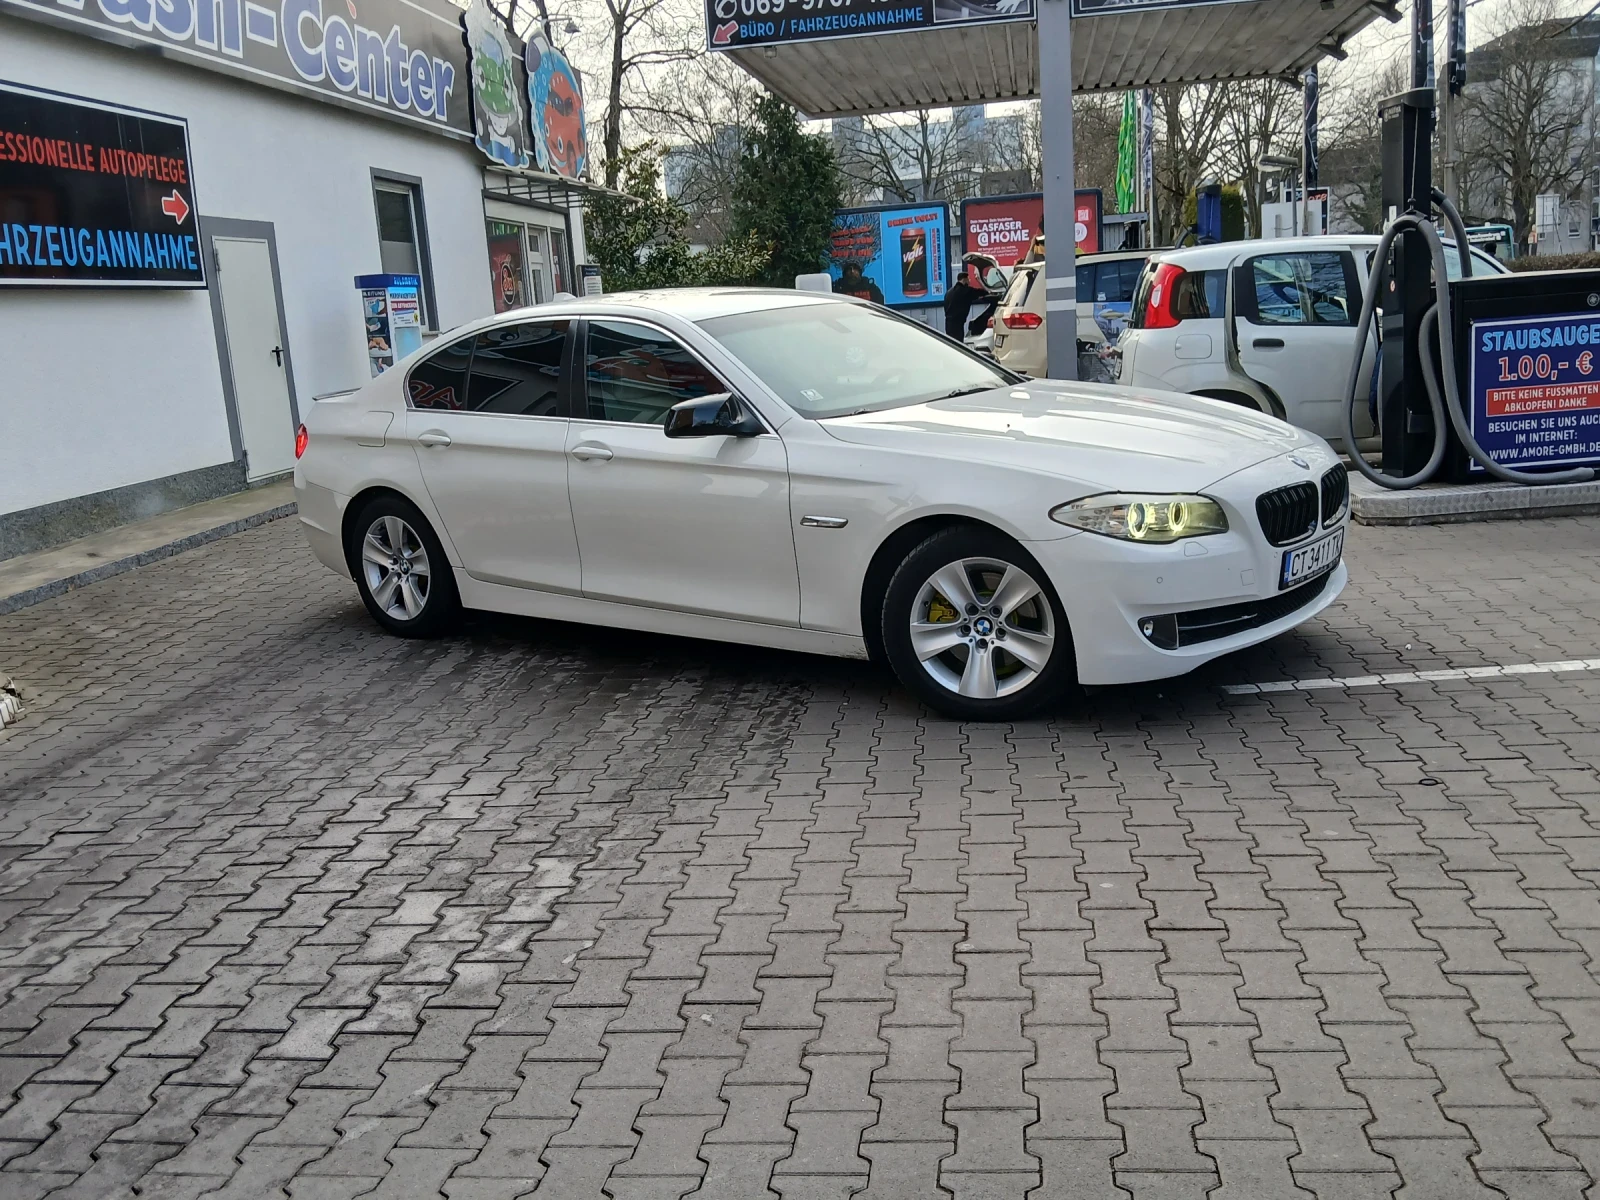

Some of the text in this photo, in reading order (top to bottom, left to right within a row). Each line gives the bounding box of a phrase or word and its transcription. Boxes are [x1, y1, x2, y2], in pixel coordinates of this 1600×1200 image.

[740, 7, 923, 38] BÜRO / FAHRZEUGANNAHME
[100, 147, 187, 184] AUTOPFLEGE
[970, 221, 1022, 233] GLASFASER
[0, 223, 197, 270] HRZEUGANNAHME
[978, 229, 1030, 247] @ HOME
[1482, 324, 1600, 352] STAUBSAUGE
[1576, 350, 1593, 375] €
[1493, 384, 1598, 401] BITTE KEINE FUSSMATTEN
[1504, 397, 1587, 412] ABKLOPFEN! DANKE
[1488, 414, 1600, 433] BESUCHEN SIE UNS AUC
[1515, 430, 1578, 444] IM INTERNET:
[1489, 442, 1600, 460] WWW.AMORE-GMBH.DE
[1291, 550, 1308, 576] CT
[1307, 539, 1331, 570] 3411
